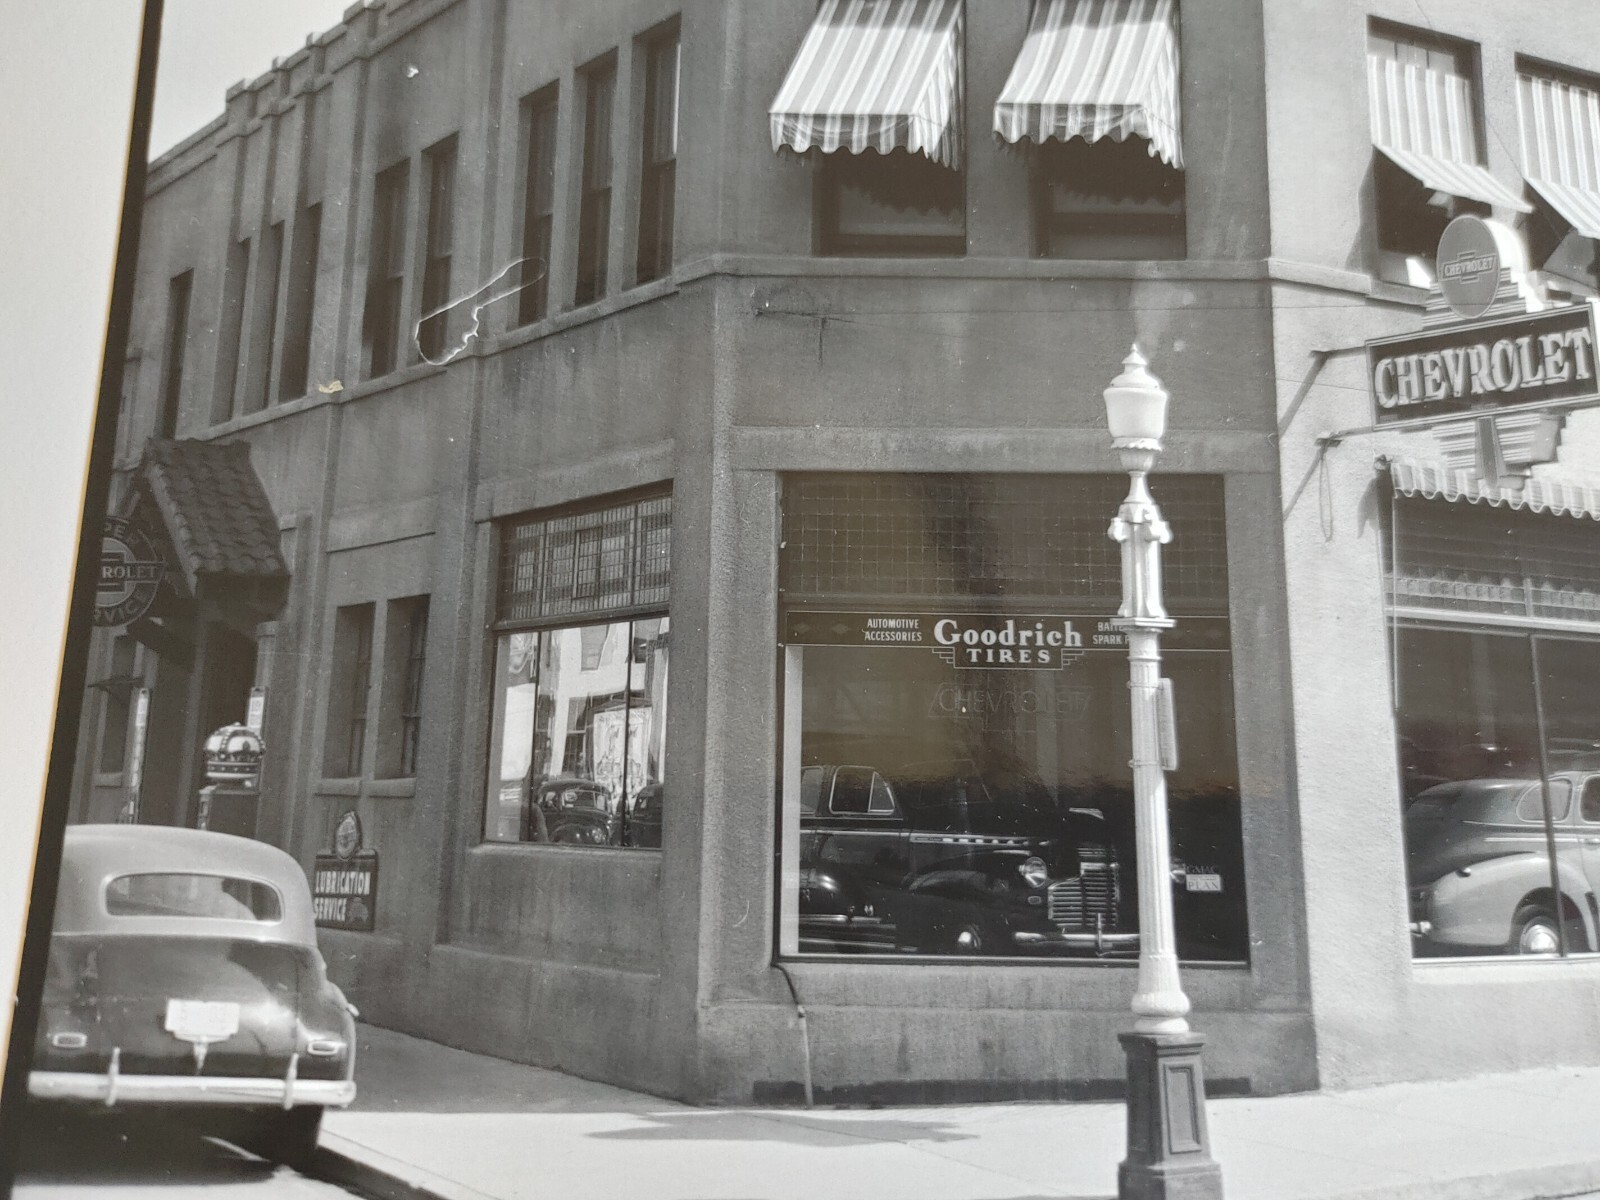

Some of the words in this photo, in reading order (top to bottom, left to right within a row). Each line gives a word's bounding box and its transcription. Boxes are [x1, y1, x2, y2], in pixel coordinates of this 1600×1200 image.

[1444, 257, 1494, 276] CHEVROLET
[1374, 327, 1593, 409] CHEVROLET
[867, 618, 920, 629] AUTOMOTIVE
[864, 630, 922, 642] ACCESSORIES
[933, 618, 1082, 648] Goodrich
[1092, 634, 1122, 645] SPARK
[966, 648, 1050, 664] TIRES
[315, 871, 371, 895] LUBRICATION
[1188, 881, 1219, 890] PLAN
[314, 897, 346, 921] SERVICE
